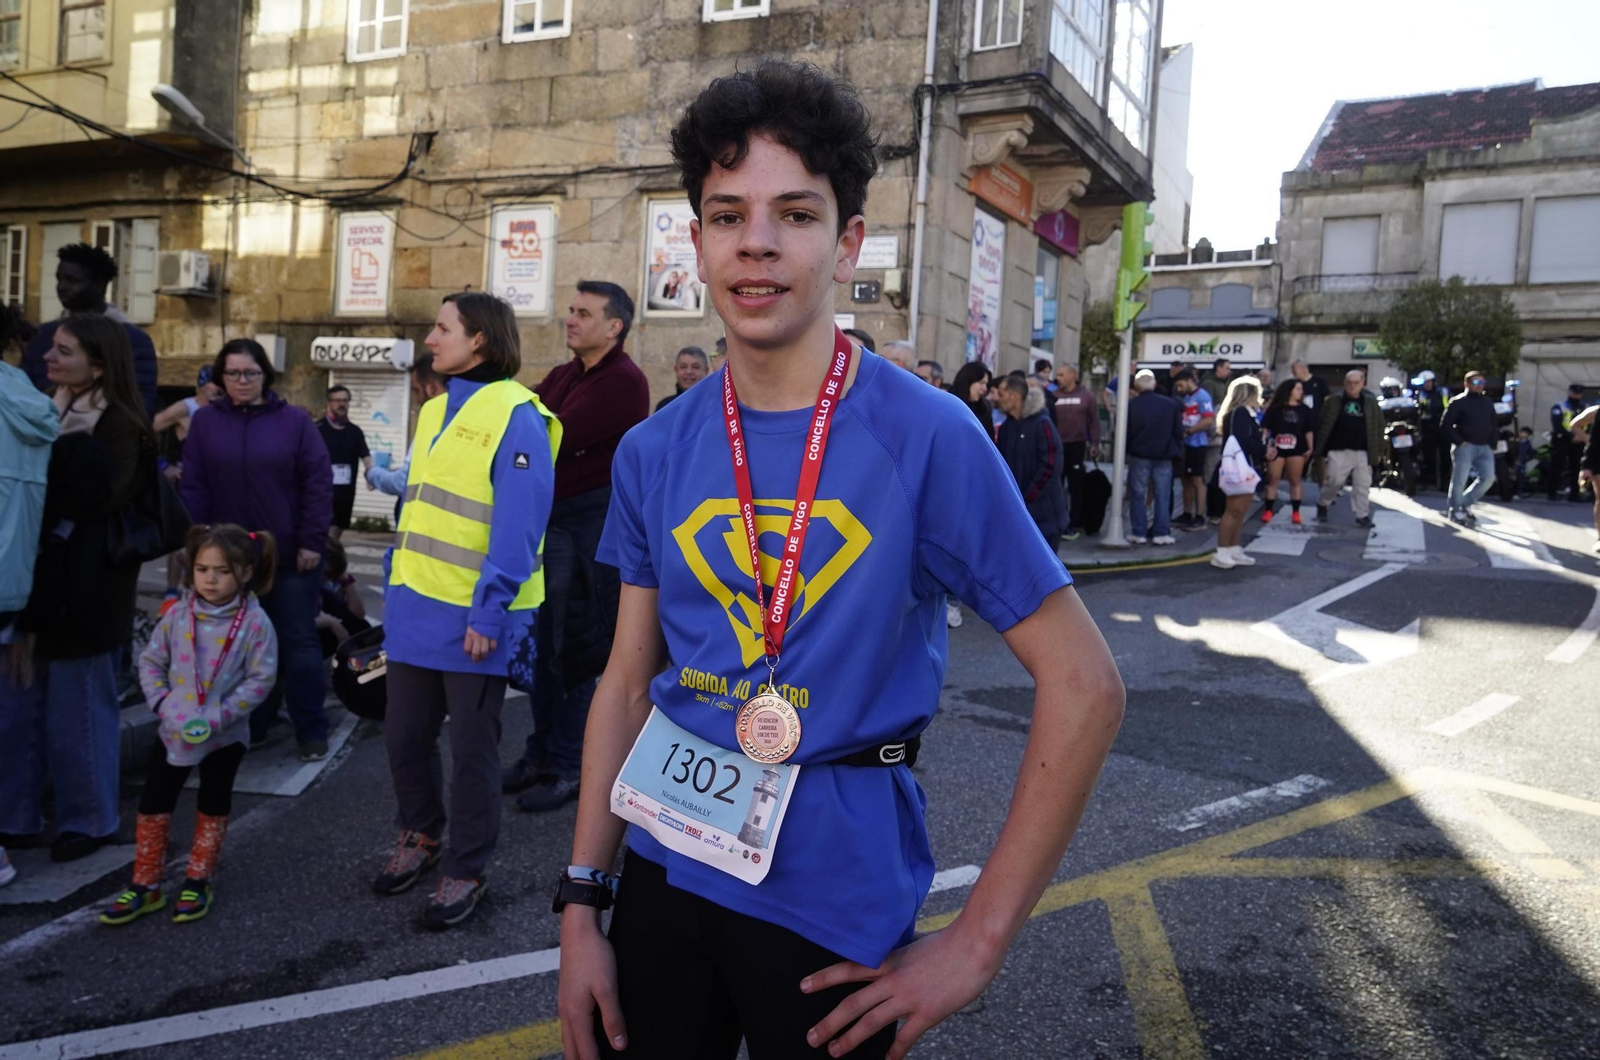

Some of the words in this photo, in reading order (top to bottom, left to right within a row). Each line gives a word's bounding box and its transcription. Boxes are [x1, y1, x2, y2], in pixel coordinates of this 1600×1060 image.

[1162, 343, 1243, 356] BOAFLOR
[808, 399, 831, 461] CONCELLO
[825, 379, 838, 396] DE
[832, 351, 846, 377] VIGO
[729, 419, 738, 436] DE
[733, 438, 743, 467] VIGO
[792, 501, 807, 531] VIGO
[743, 503, 758, 565] CONCELLO
[788, 536, 799, 553] DE
[771, 558, 794, 624] CONCELLO
[679, 666, 729, 697] SUBIDA
[731, 678, 751, 701] AO
[758, 683, 809, 709] CTRO
[740, 699, 775, 732] CONCELLO
[775, 702, 789, 715] DE
[661, 743, 741, 805] 1302
[632, 800, 658, 819] Santander
[661, 789, 680, 805] Nicolás
[680, 799, 712, 818] AUBAILLY
[659, 813, 684, 831] DECATHLON
[685, 825, 703, 838] FROIZ
[703, 837, 725, 850] amura
